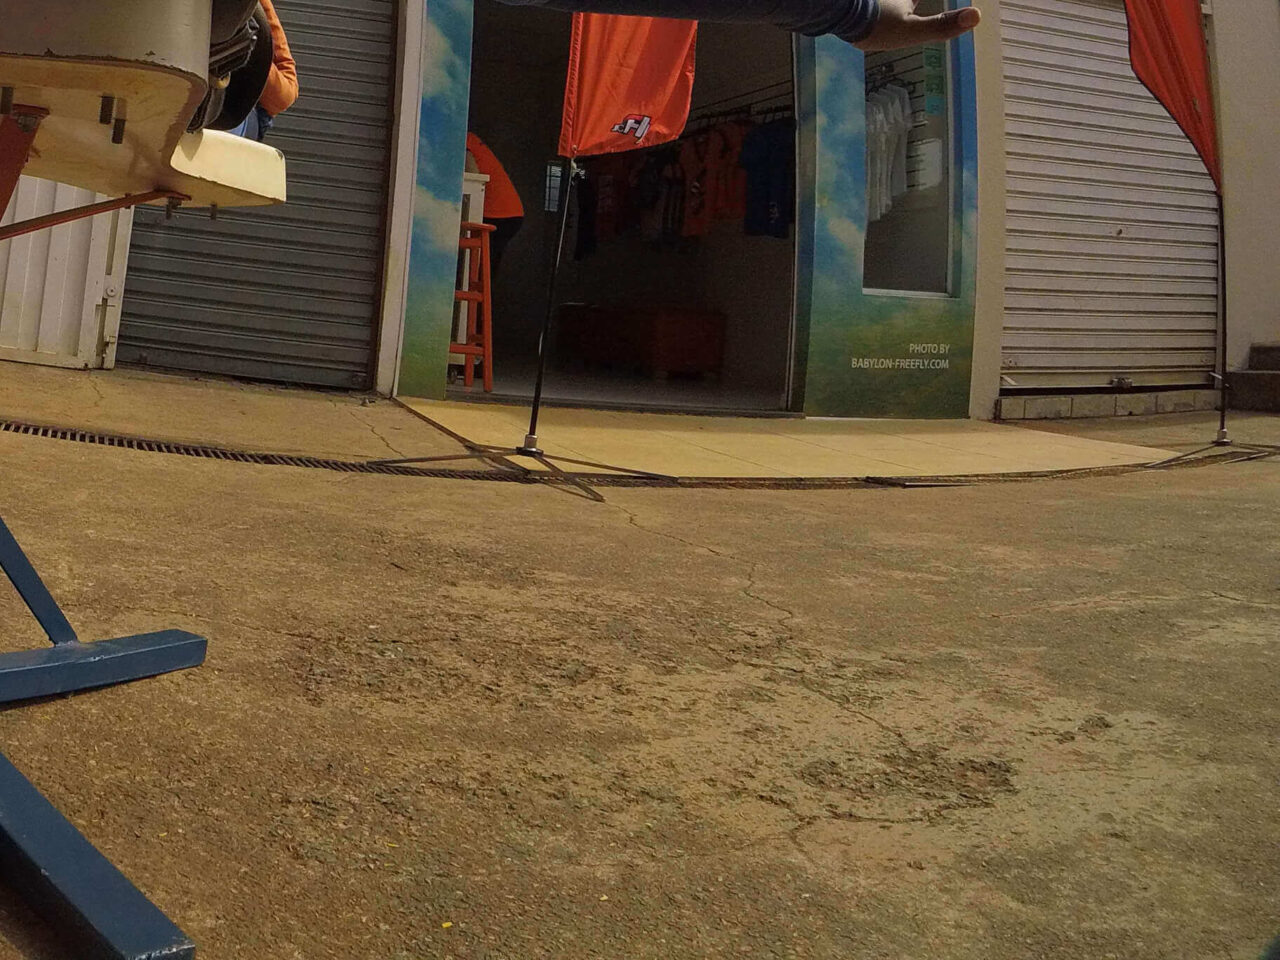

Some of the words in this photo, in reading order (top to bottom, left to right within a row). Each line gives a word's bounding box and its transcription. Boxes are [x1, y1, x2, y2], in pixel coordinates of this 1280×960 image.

[909, 343, 938, 354] PHOTO
[939, 343, 951, 354] BY
[851, 358, 950, 369] BABYLON-FREEFLY.COM
